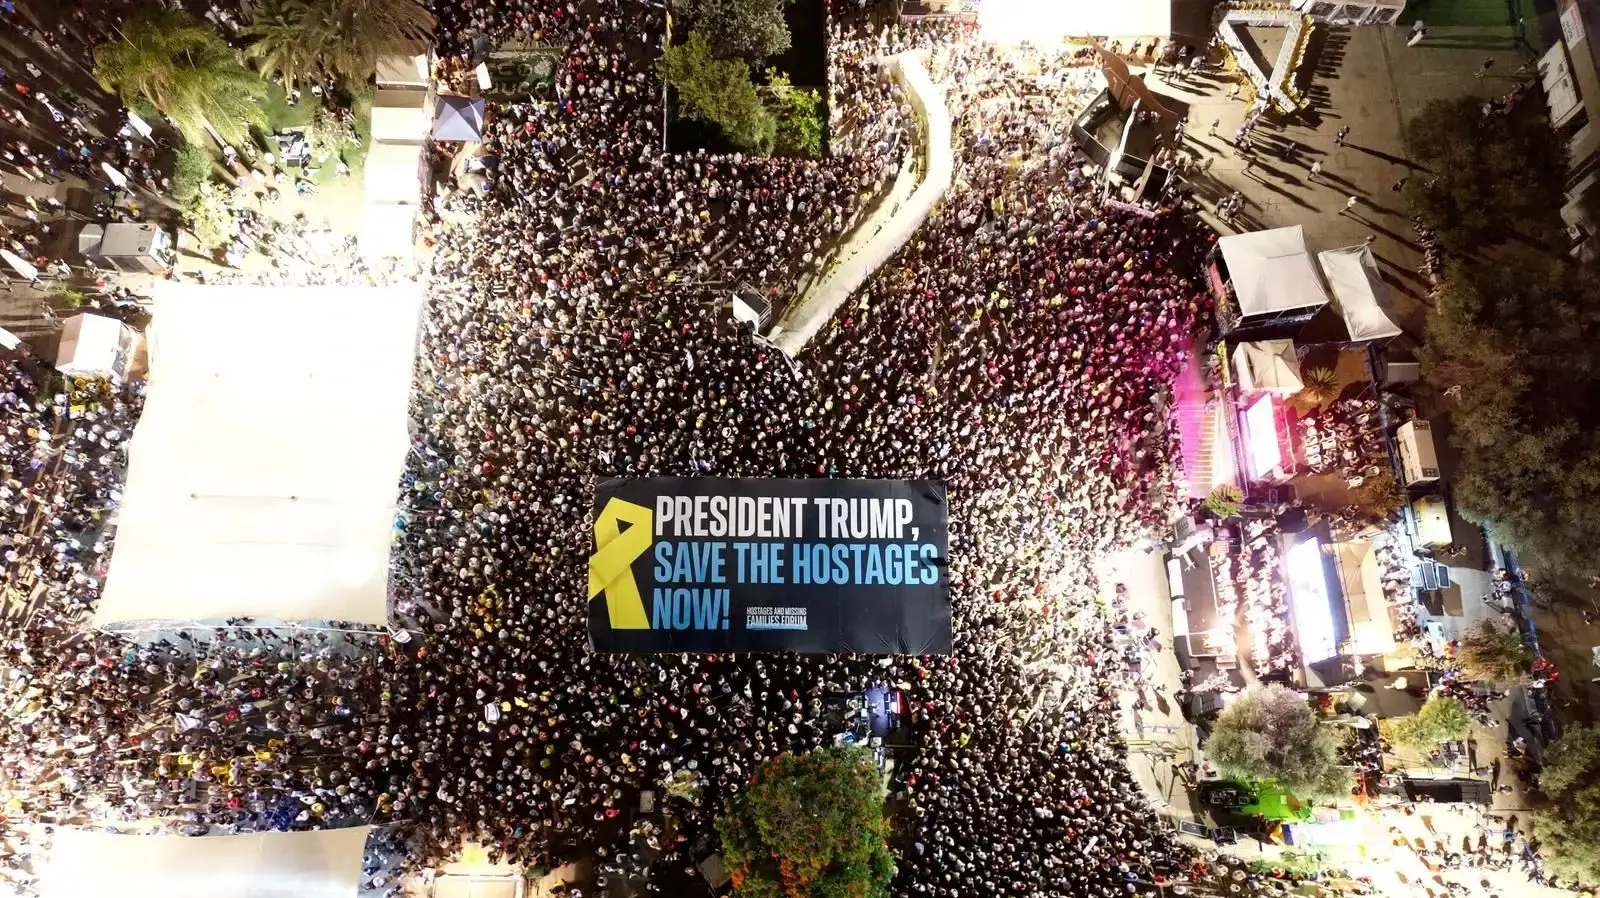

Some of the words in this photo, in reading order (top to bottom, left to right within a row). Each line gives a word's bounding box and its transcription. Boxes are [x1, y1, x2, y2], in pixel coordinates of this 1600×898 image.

[656, 496, 807, 538] PRESIDENT
[814, 497, 919, 542] TRUMP,
[654, 542, 726, 583] SAVE
[733, 543, 784, 584] THE
[793, 543, 938, 585] HOSTAGES
[653, 588, 729, 630] NOW!
[747, 607, 773, 615] HOSTAGES
[774, 607, 784, 615] AND
[785, 607, 807, 616] MISSING
[747, 615, 779, 625] FAMILIES
[782, 615, 807, 625] FORUM
